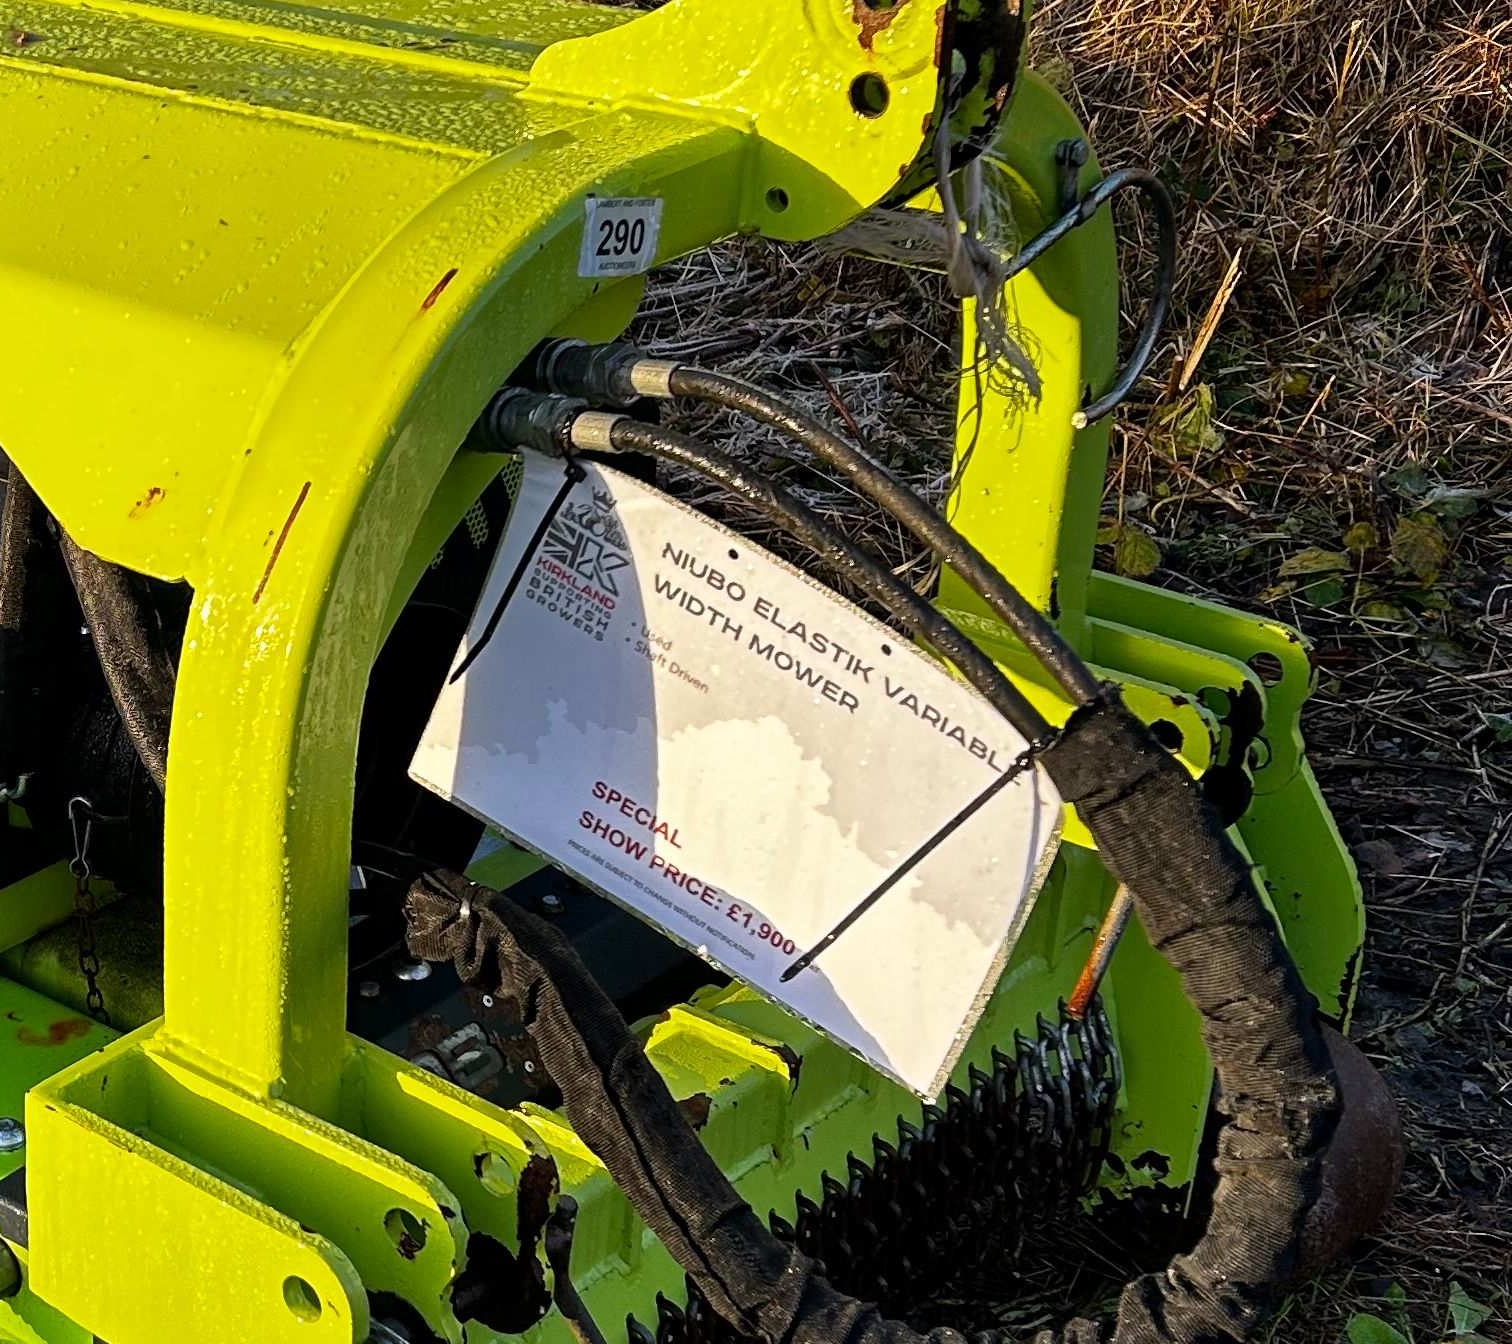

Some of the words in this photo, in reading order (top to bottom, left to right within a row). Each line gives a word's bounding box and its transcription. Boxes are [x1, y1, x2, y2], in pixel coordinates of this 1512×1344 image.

[596, 218, 646, 256] 290
[530, 576, 610, 632] BRITISH
[534, 567, 613, 619] SUPPORTING
[537, 557, 616, 610] KIRKLAND
[526, 589, 605, 642] GROWERS
[640, 625, 672, 652] Used
[634, 640, 667, 668] Shaft
[668, 660, 709, 694] Driven
[654, 574, 743, 642] WIDTH
[748, 634, 860, 714] MOWER
[661, 542, 746, 602] NIUBO
[752, 596, 875, 684] ELASTIK
[884, 676, 1020, 786] VARIABL
[591, 781, 682, 849] SPECIAL
[578, 811, 648, 860] SHOW
[648, 854, 723, 911] PRICE:
[726, 903, 796, 956] £1,900
